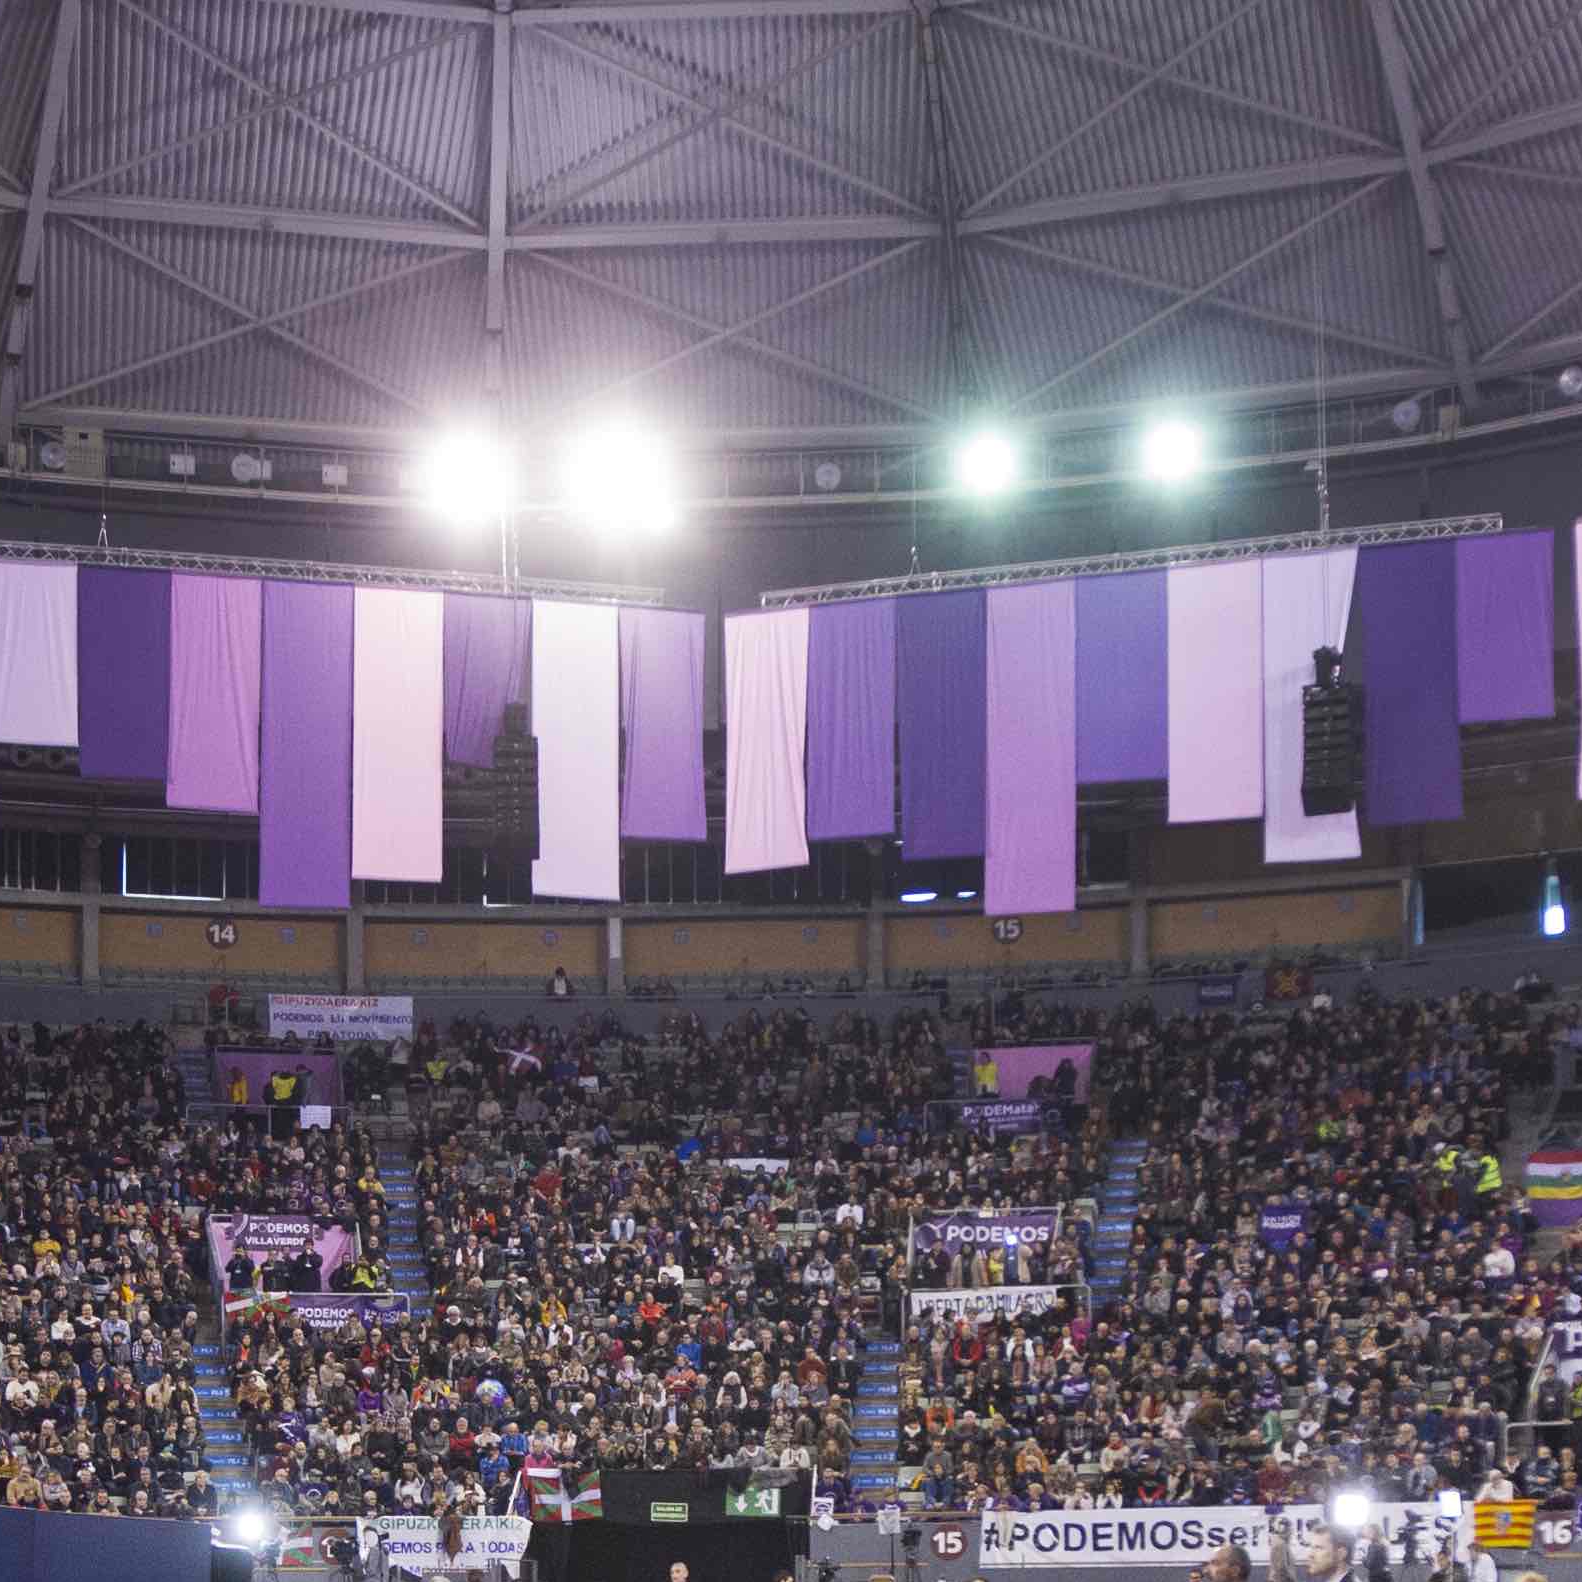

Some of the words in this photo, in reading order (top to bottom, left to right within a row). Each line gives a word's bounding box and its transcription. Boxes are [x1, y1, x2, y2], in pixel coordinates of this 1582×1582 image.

[209, 924, 236, 944] 14
[994, 919, 1021, 940] 15
[249, 1222, 310, 1235] PODEMOS
[932, 1531, 963, 1554] 15
[1537, 1519, 1573, 1545] 16
